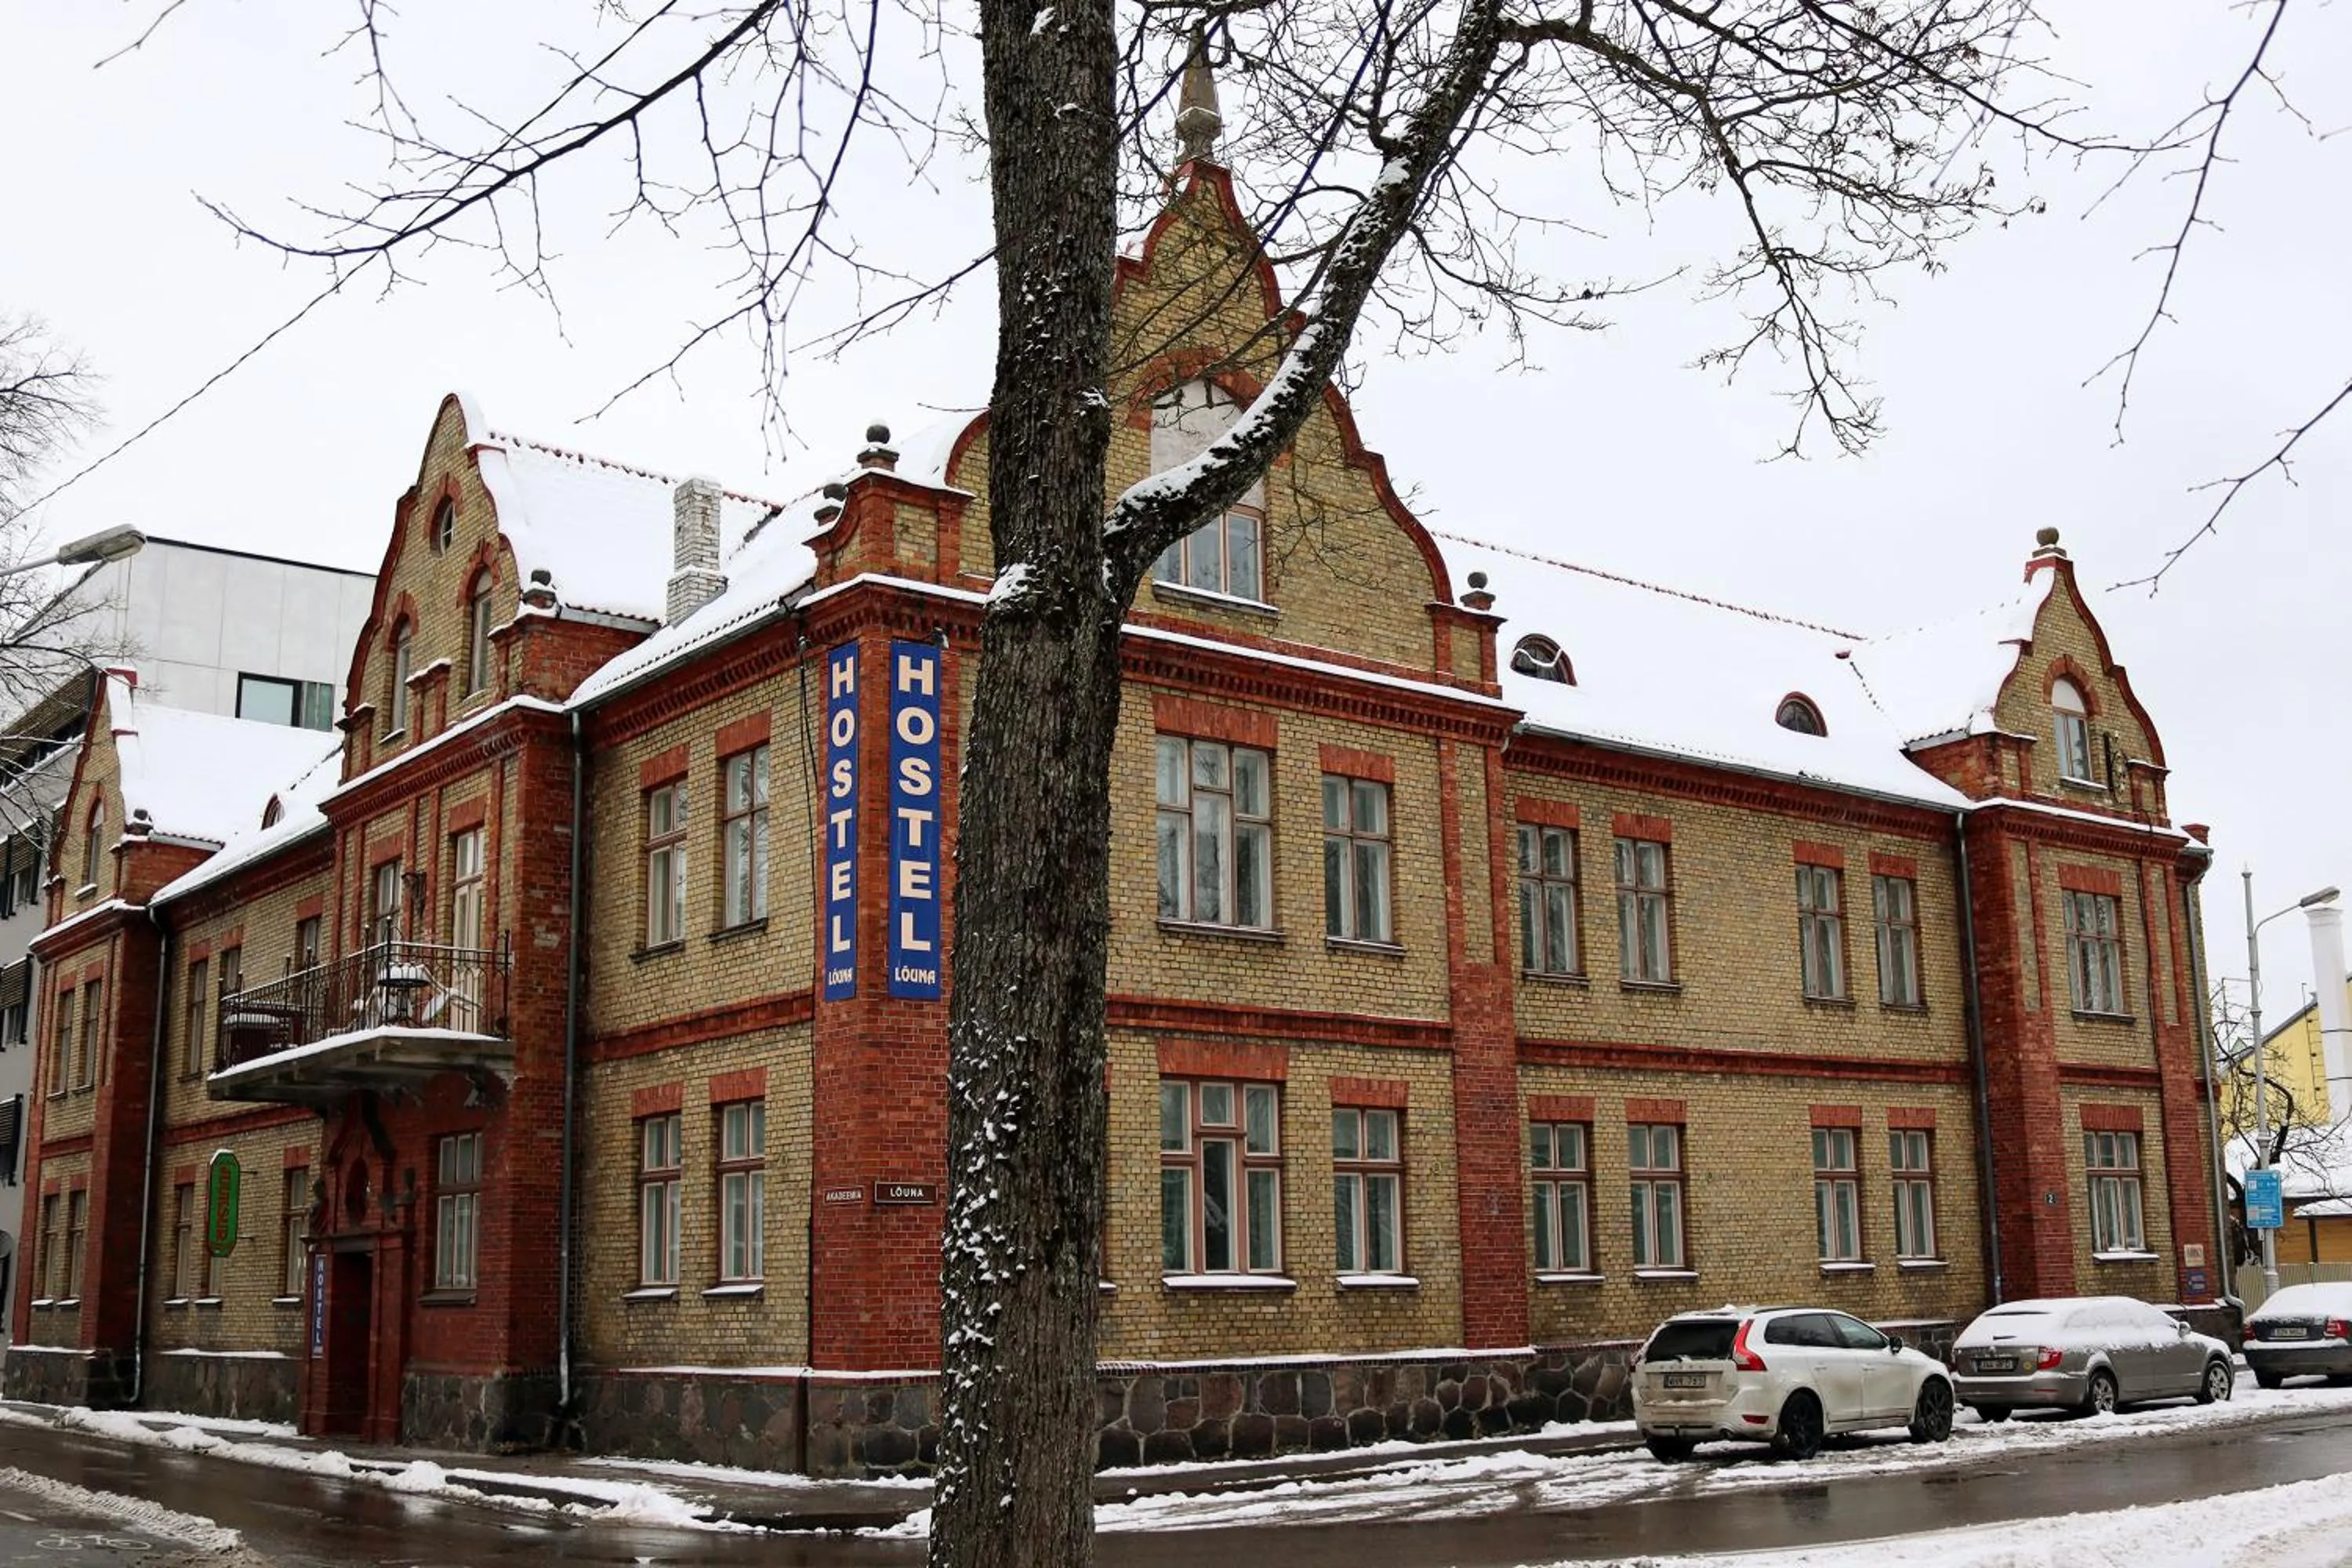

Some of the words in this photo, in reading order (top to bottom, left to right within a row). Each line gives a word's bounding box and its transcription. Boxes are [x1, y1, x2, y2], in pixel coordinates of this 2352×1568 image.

[831, 655, 855, 953] HOSTEL
[897, 655, 935, 951] HOSTEL
[895, 966, 935, 985] LÕUNA
[890, 1185, 924, 1197] LÕUNA
